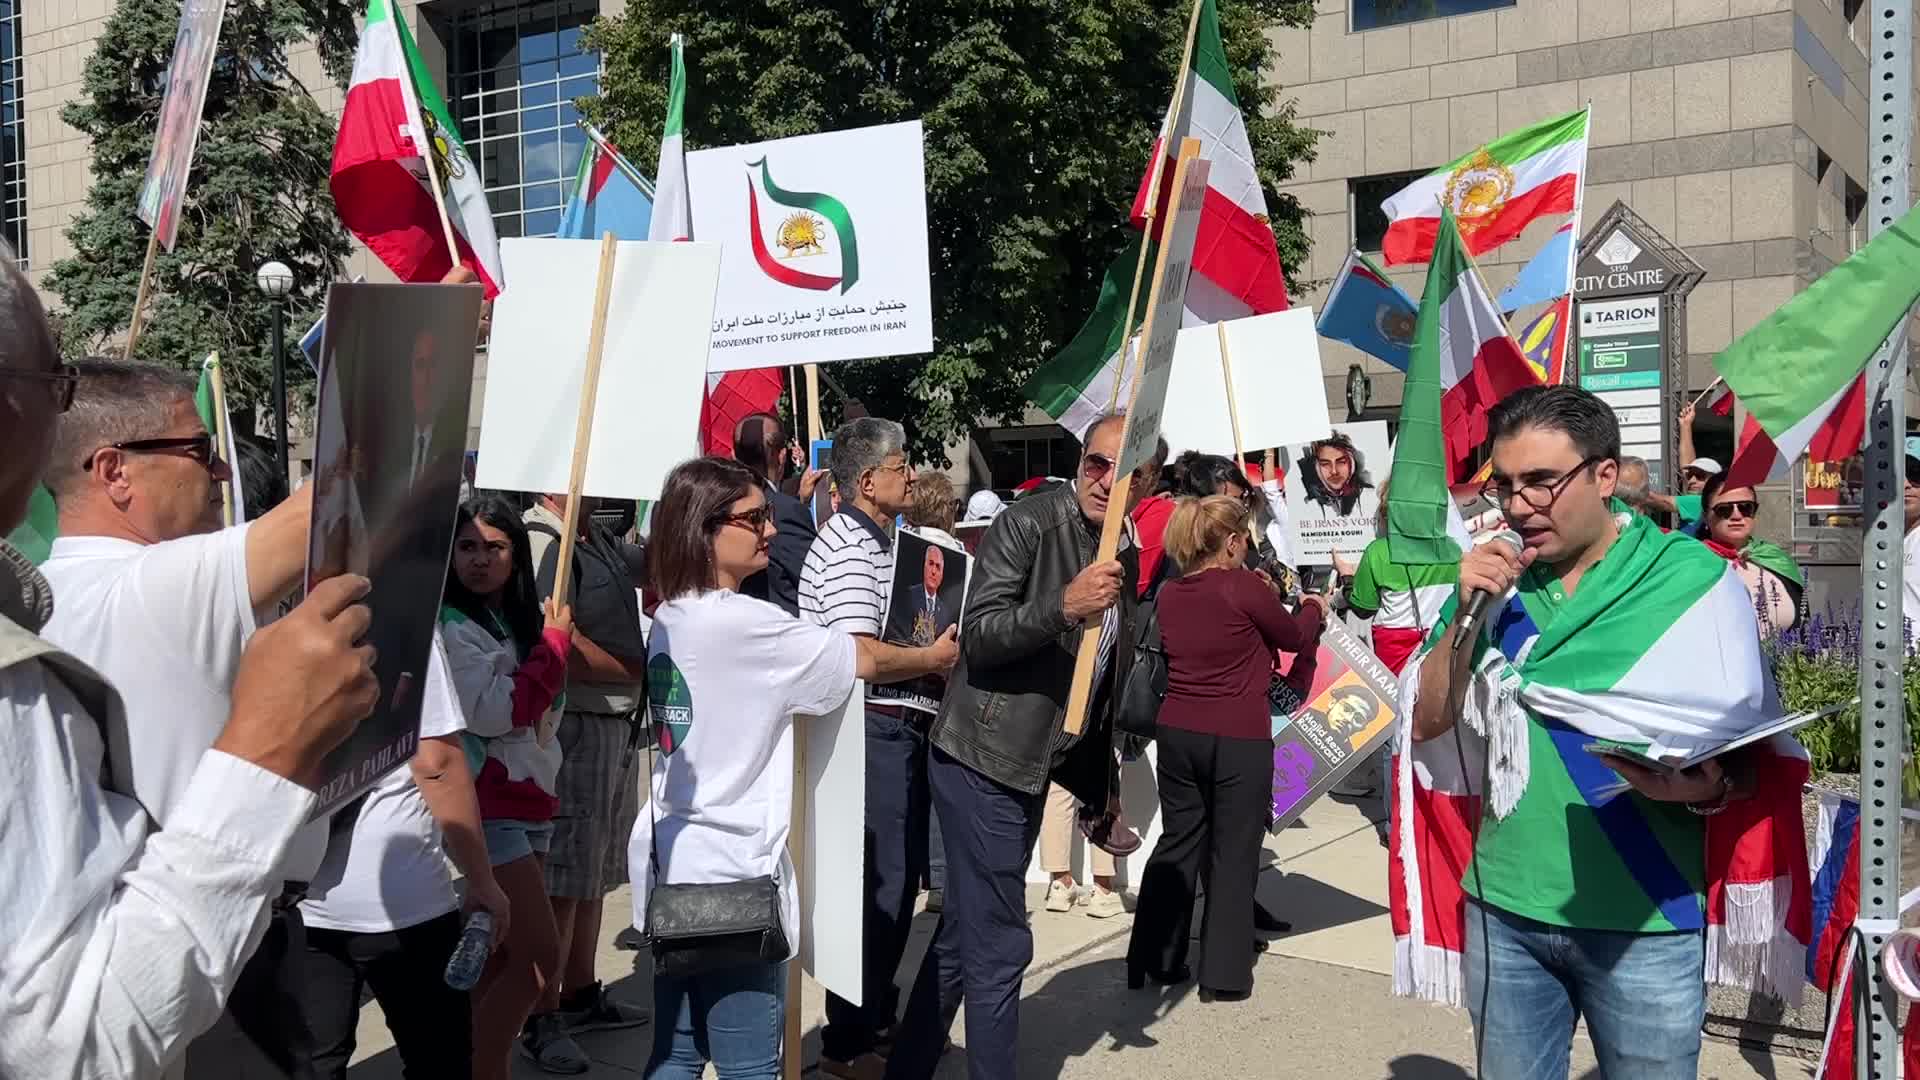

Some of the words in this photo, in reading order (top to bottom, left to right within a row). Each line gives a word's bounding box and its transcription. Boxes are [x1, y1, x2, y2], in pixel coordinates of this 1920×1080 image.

[1575, 275, 1605, 292] CITY
[1608, 268, 1664, 289] CENTRE
[815, 307, 825, 322] از
[829, 304, 865, 320] حمایت
[870, 299, 907, 315] جنبش
[1595, 307, 1656, 322] TARION
[712, 316, 739, 332] ایران
[742, 314, 764, 326] ملت
[767, 310, 811, 325] مبارزات
[712, 336, 764, 349] MOVEMENT
[766, 334, 778, 343] TO
[781, 329, 821, 341] SUPPORT
[823, 324, 868, 336] FREEDOM
[870, 323, 881, 332] IN
[884, 320, 907, 331] IRAN
[1300, 520, 1312, 528] BE
[1315, 518, 1349, 529] IRAN'S
[1350, 517, 1377, 527] VOIC
[1338, 633, 1370, 667] THEIR
[1367, 664, 1399, 702] NAM
[879, 686, 898, 698] KING
[1297, 718, 1340, 764] Rahnavard
[1302, 711, 1328, 737] Majid
[1324, 735, 1346, 759] Reza
